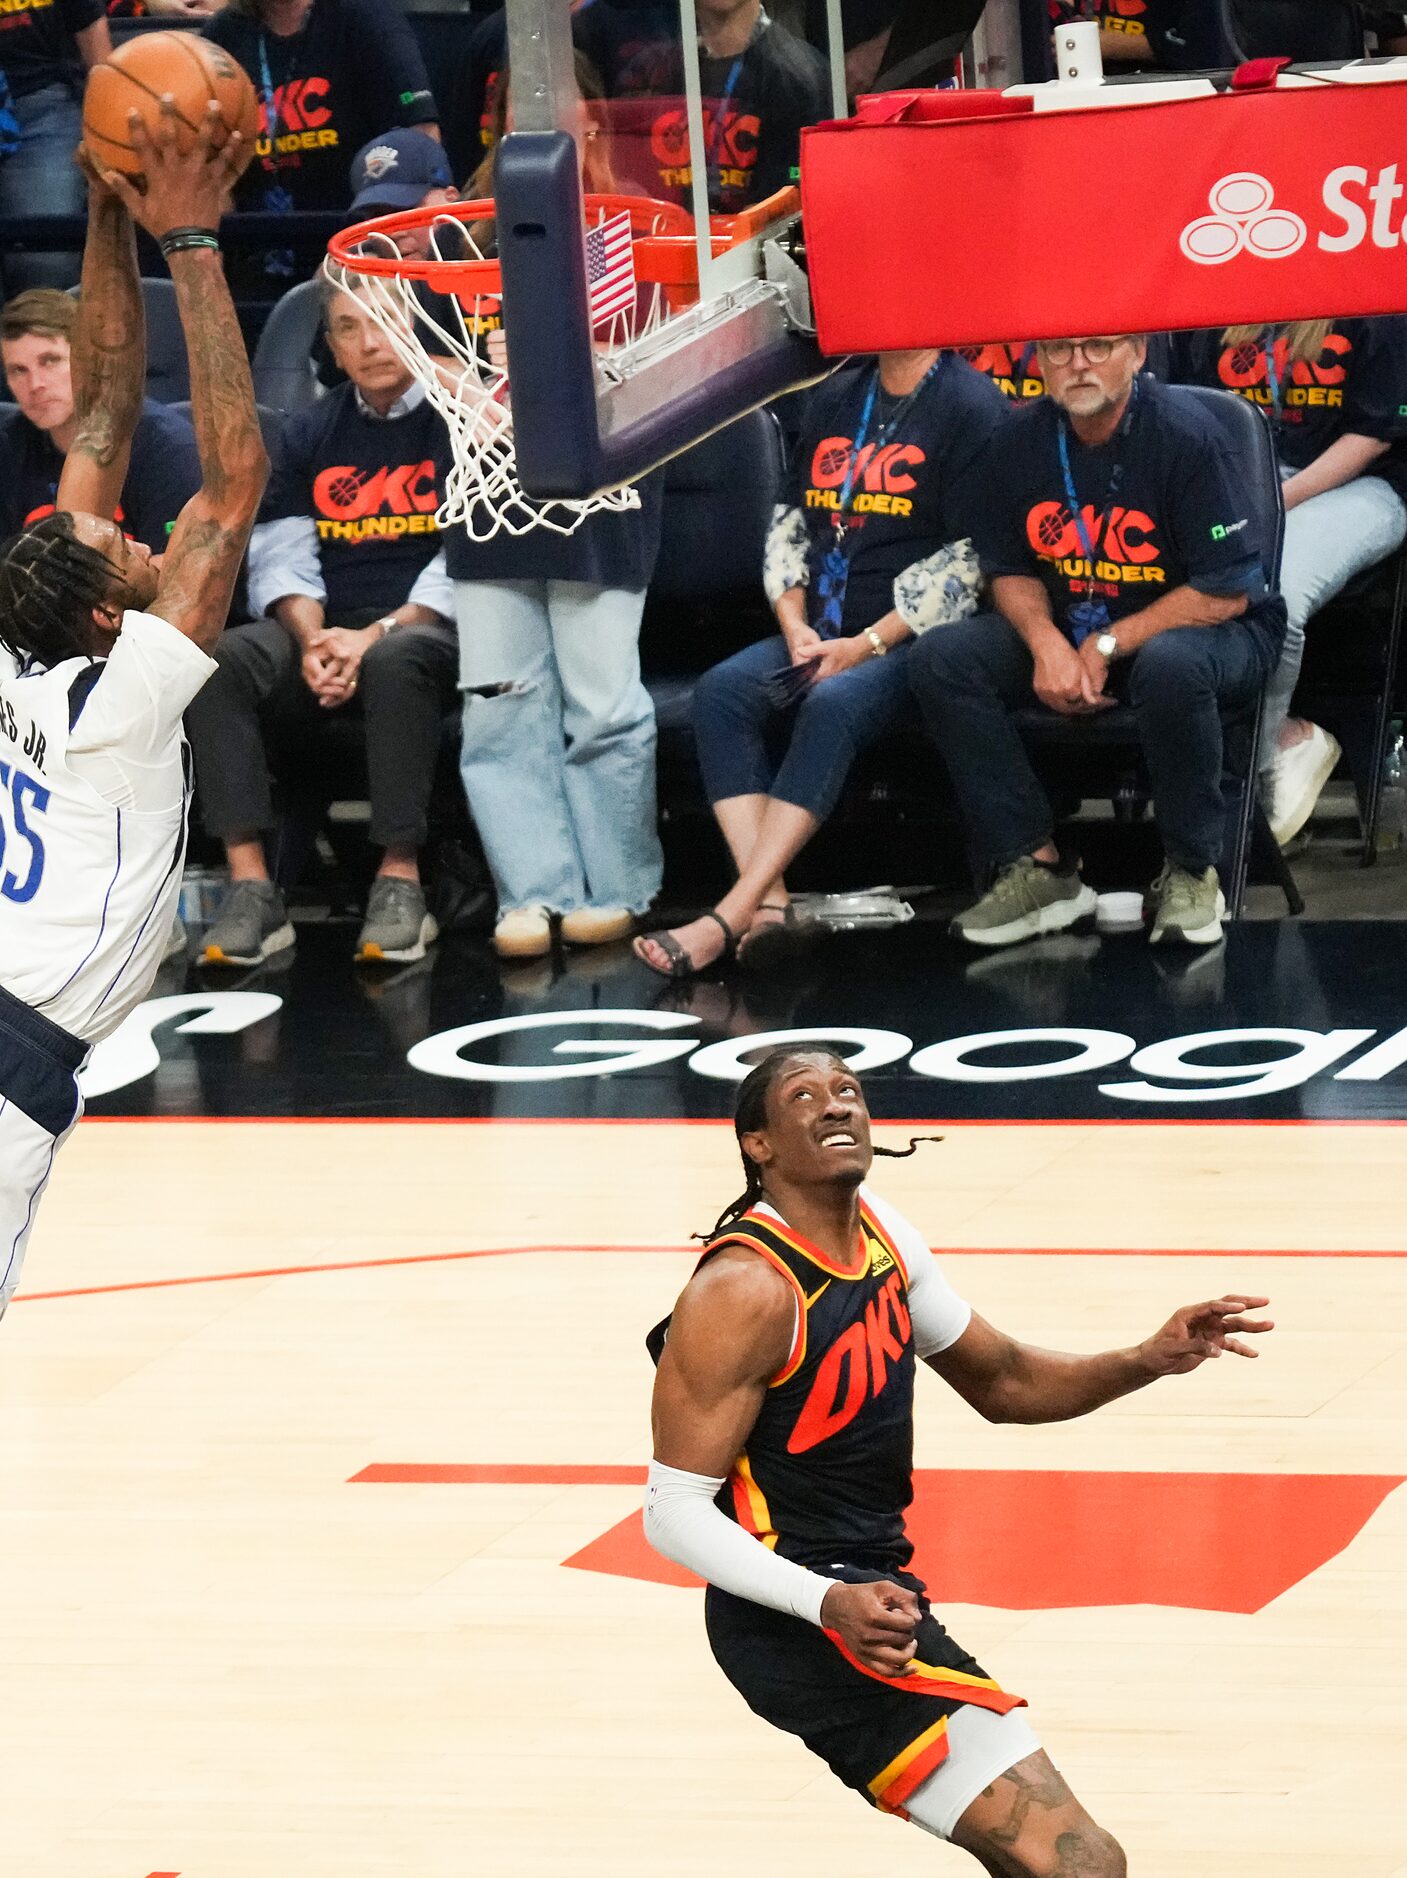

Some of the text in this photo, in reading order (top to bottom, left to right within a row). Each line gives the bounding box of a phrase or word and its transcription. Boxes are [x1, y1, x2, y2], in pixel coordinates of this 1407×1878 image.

[1317, 163, 1407, 252] St
[314, 460, 438, 521] OKC
[811, 436, 926, 493] OKC
[1026, 501, 1161, 564] OKC
[23, 719, 47, 776] JR.
[787, 1271, 912, 1455] OKC
